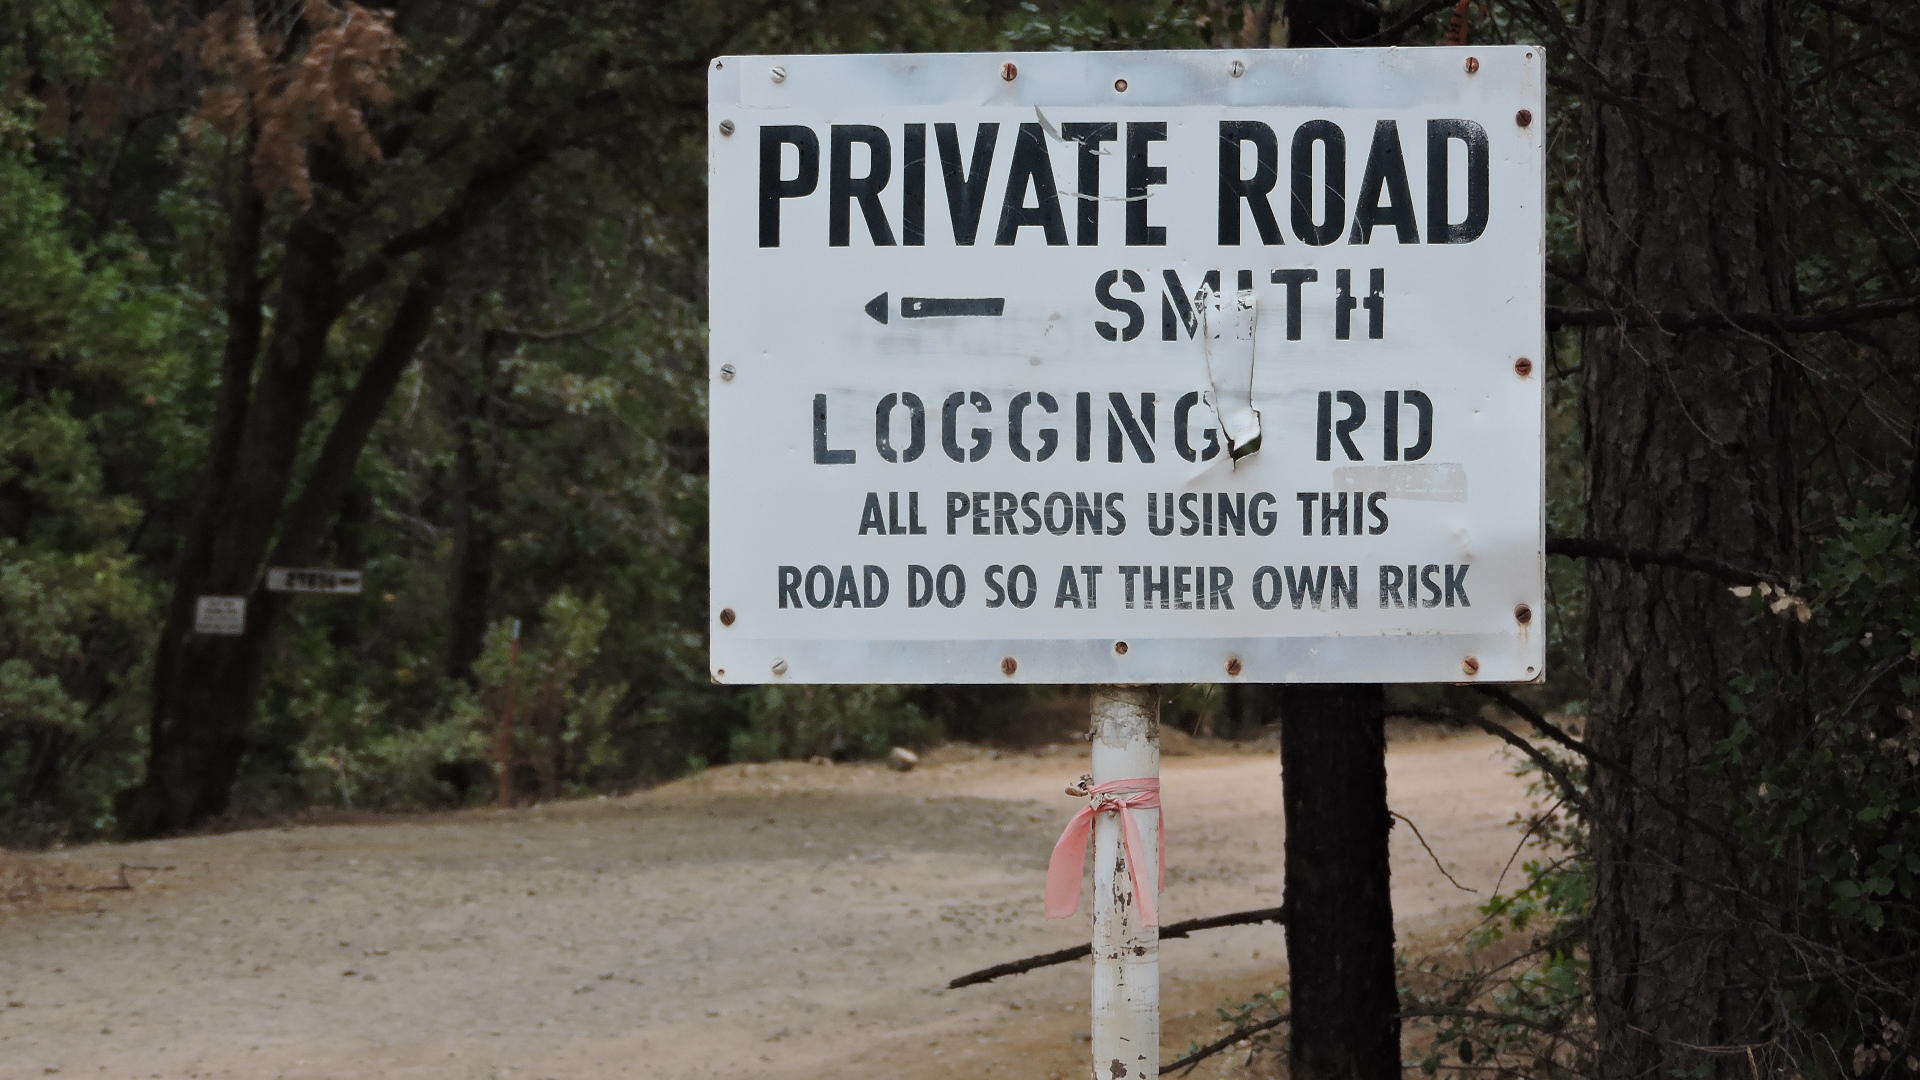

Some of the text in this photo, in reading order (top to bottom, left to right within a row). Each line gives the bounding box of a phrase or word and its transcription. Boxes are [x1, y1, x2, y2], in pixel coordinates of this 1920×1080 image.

[758, 118, 1490, 248] PRIVATE ROAD
[813, 389, 1434, 465] LOGGING RD
[858, 491, 1389, 538] ALL PERSONS USING THIS
[778, 563, 1471, 611] ROAD DO SO AT THEIR OWN RISK
